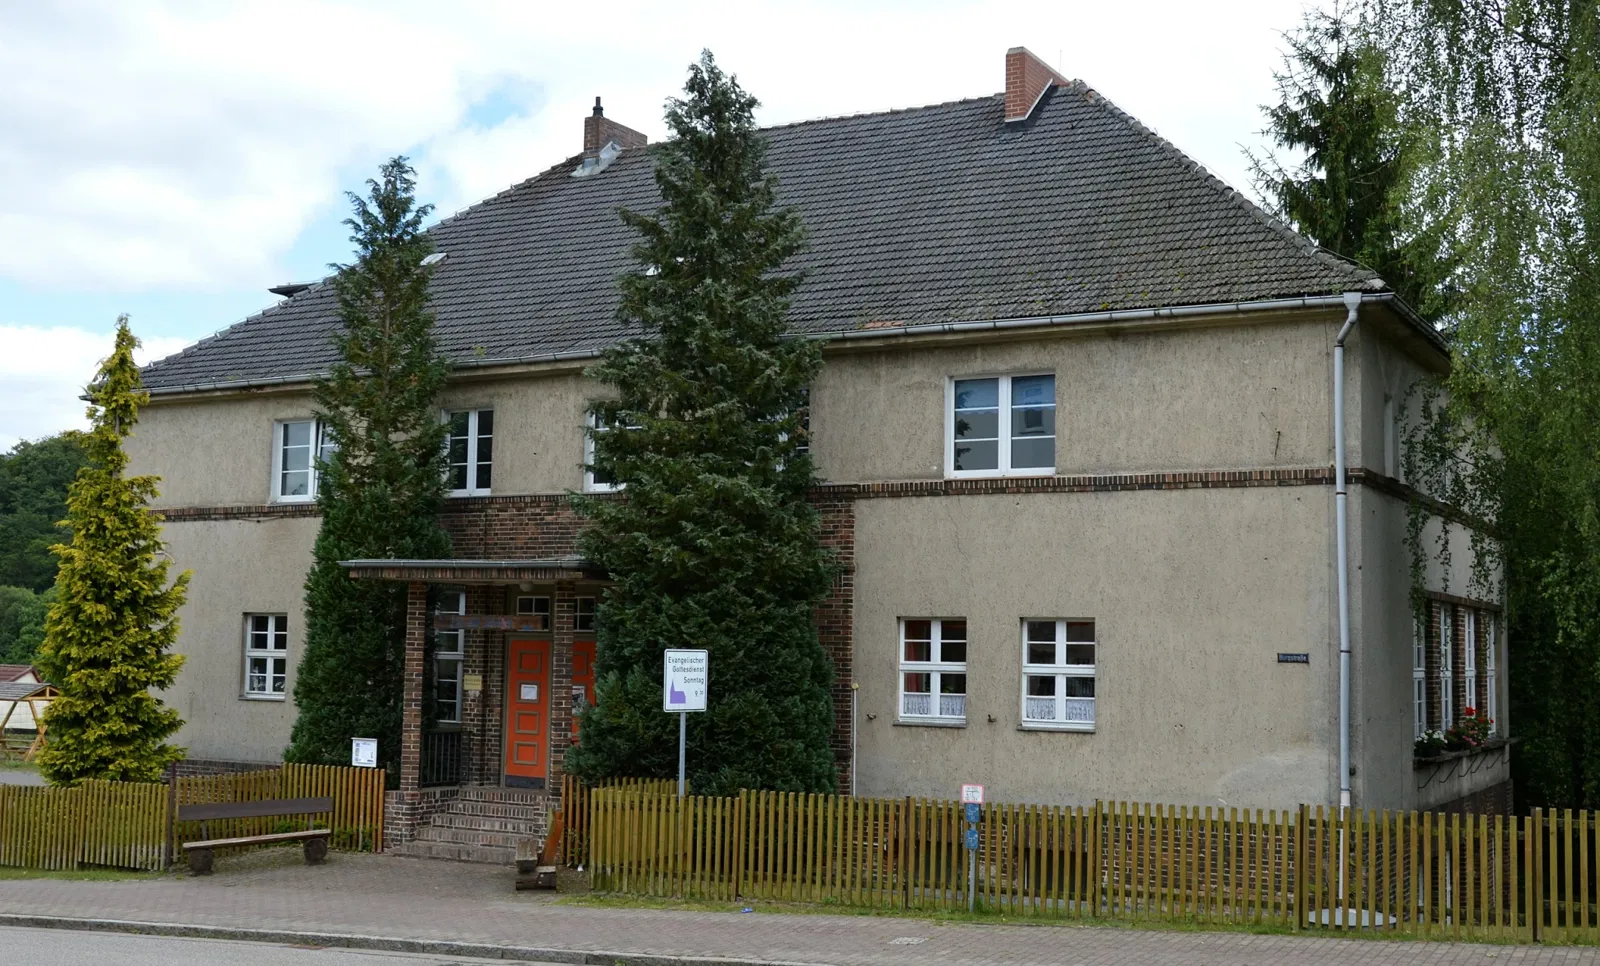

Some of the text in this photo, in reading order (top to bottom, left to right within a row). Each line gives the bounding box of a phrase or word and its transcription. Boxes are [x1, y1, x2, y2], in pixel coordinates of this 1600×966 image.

[668, 656, 704, 665] Evangelischer
[672, 665, 704, 673] Gottesdienst
[684, 676, 704, 685] Sonntag
